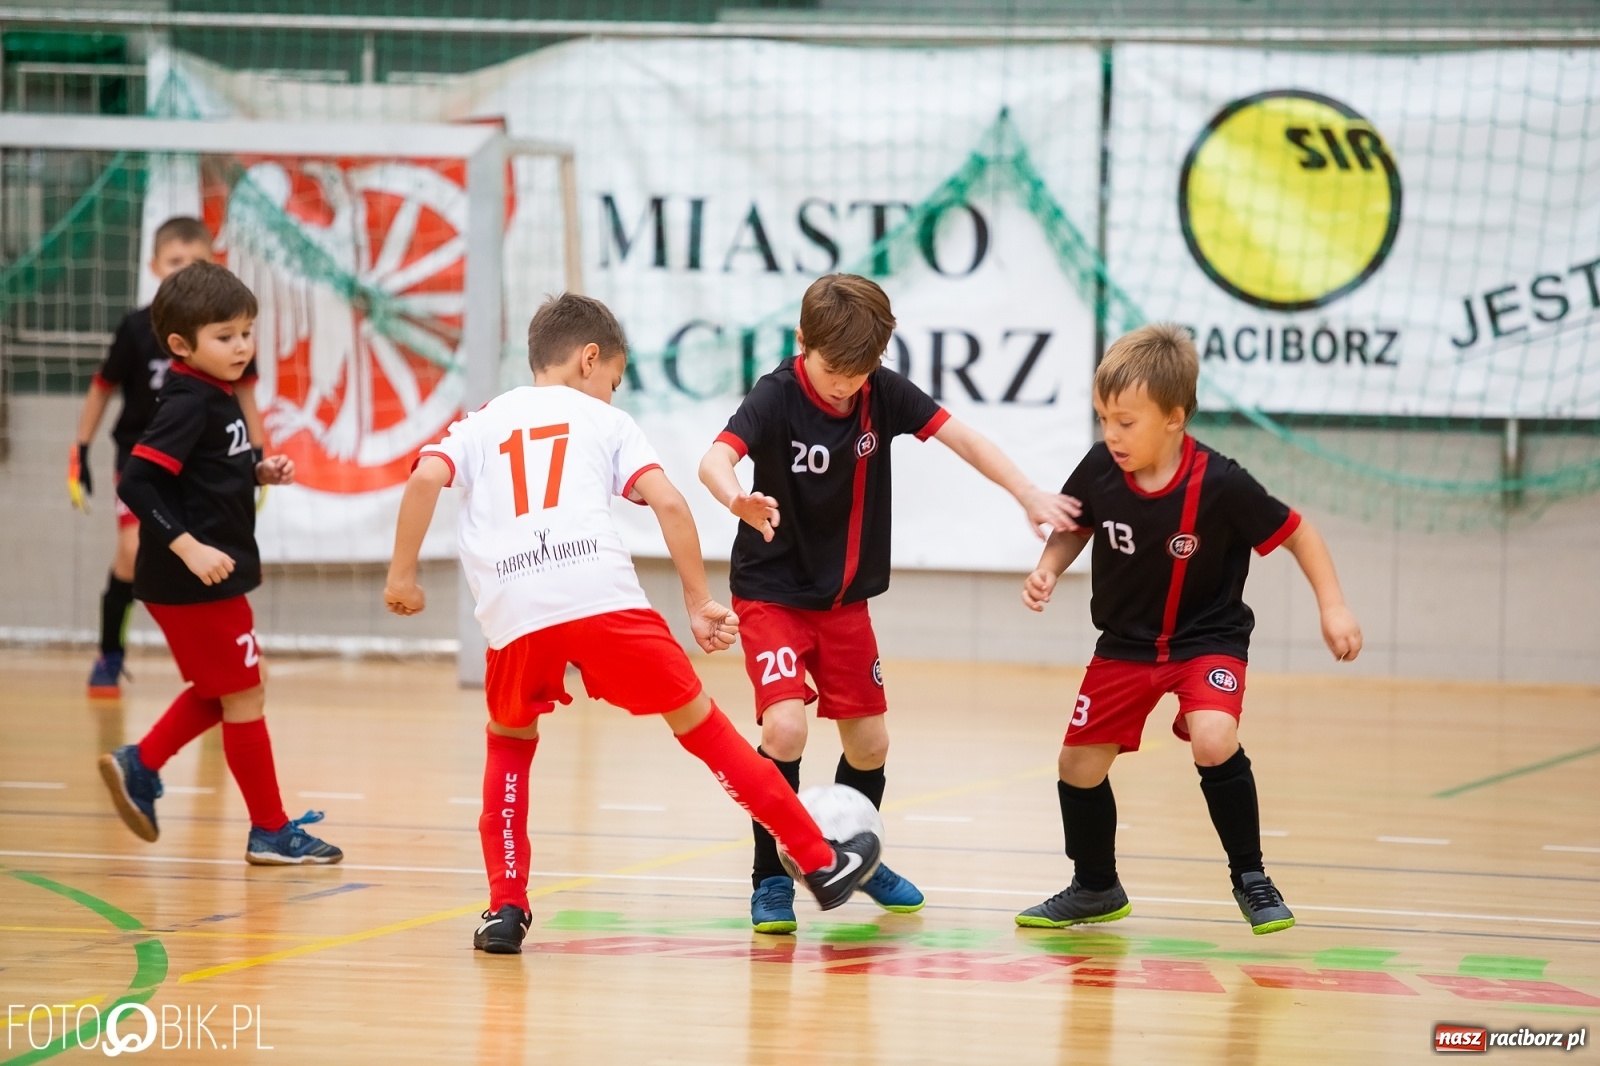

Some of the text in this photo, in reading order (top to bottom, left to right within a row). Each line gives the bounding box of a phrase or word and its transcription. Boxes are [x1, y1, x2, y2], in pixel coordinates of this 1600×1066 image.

[597, 193, 993, 279] MIASTO
[1451, 258, 1600, 348] JEST
[1184, 322, 1399, 366] ACIBÓRZ
[226, 419, 252, 456] 22
[499, 423, 570, 518] 17
[791, 441, 830, 474] 20
[1102, 520, 1136, 555] 13
[496, 542, 552, 578] FABRYKA
[552, 539, 598, 561] URODY
[235, 629, 259, 668] 2
[756, 646, 797, 686] 20
[1071, 694, 1091, 727] 3
[501, 773, 517, 879] UKS CIESZYN
